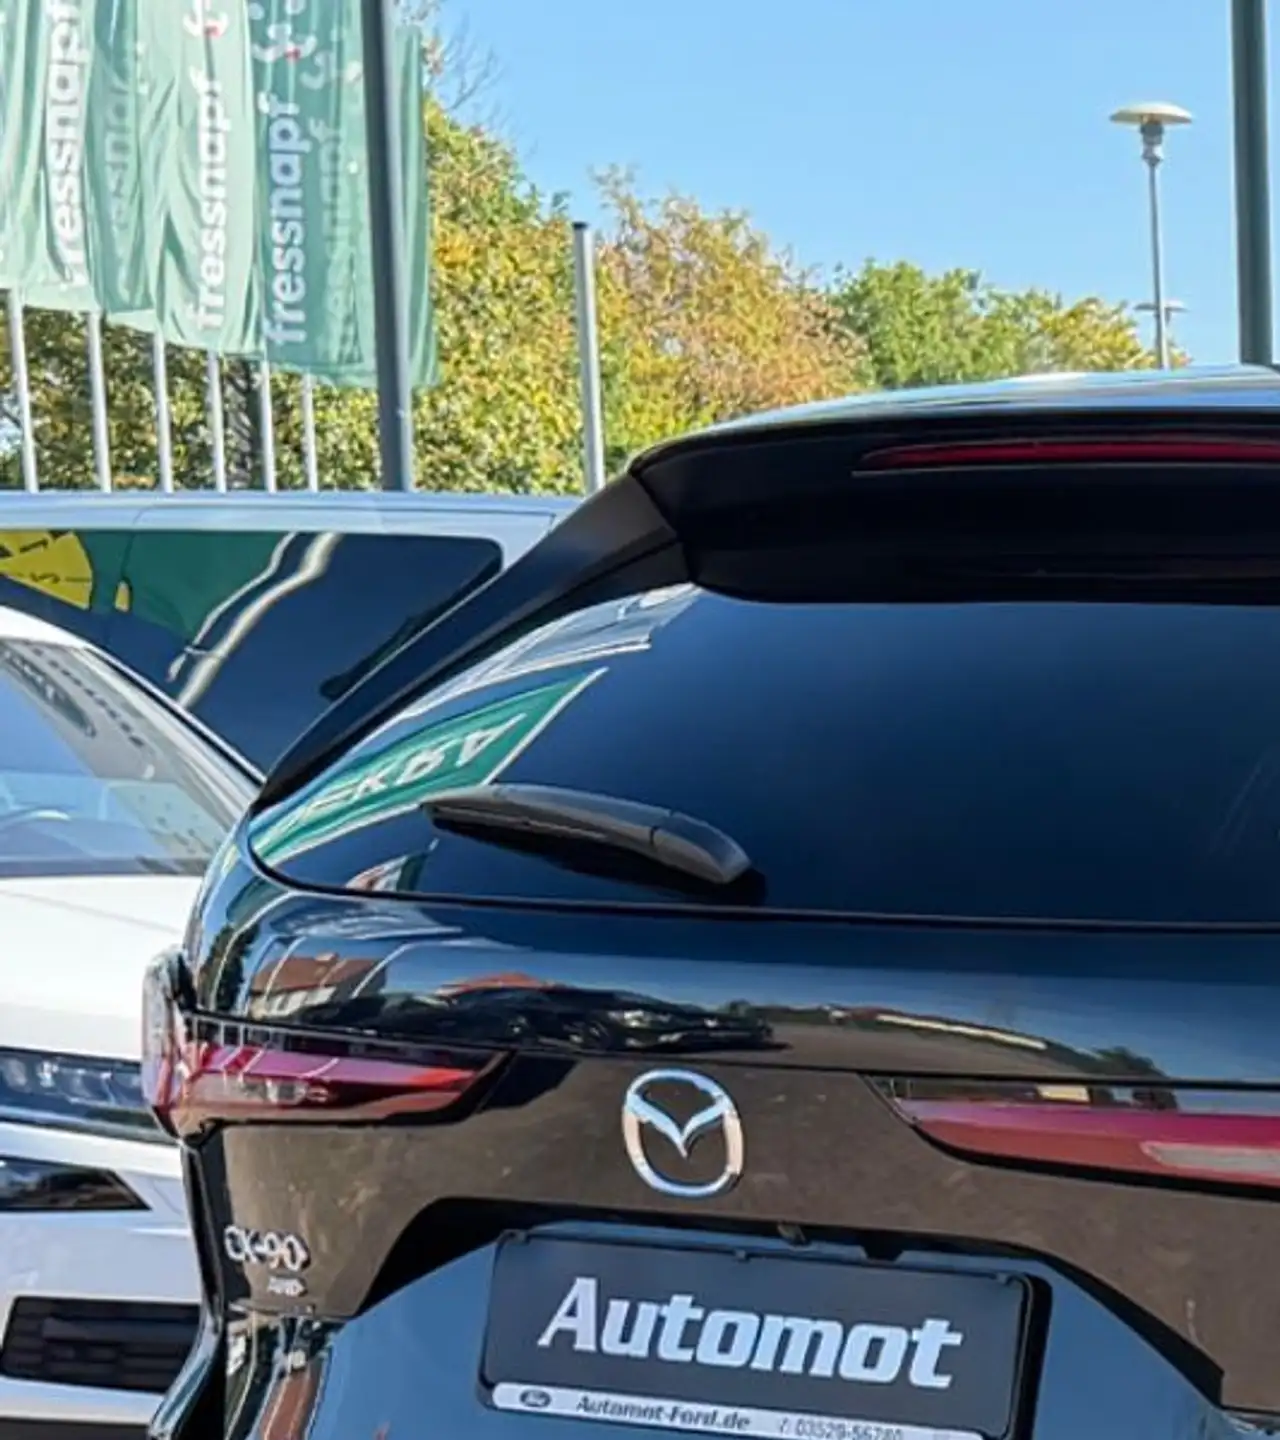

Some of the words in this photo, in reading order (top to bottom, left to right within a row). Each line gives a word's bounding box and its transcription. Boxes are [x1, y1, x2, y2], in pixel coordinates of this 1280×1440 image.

[188, 65, 232, 331] fressnapf
[259, 90, 311, 345] fressnapf
[537, 1276, 962, 1389] Automot
[575, 1394, 751, 1432] Automot-Ford.de
